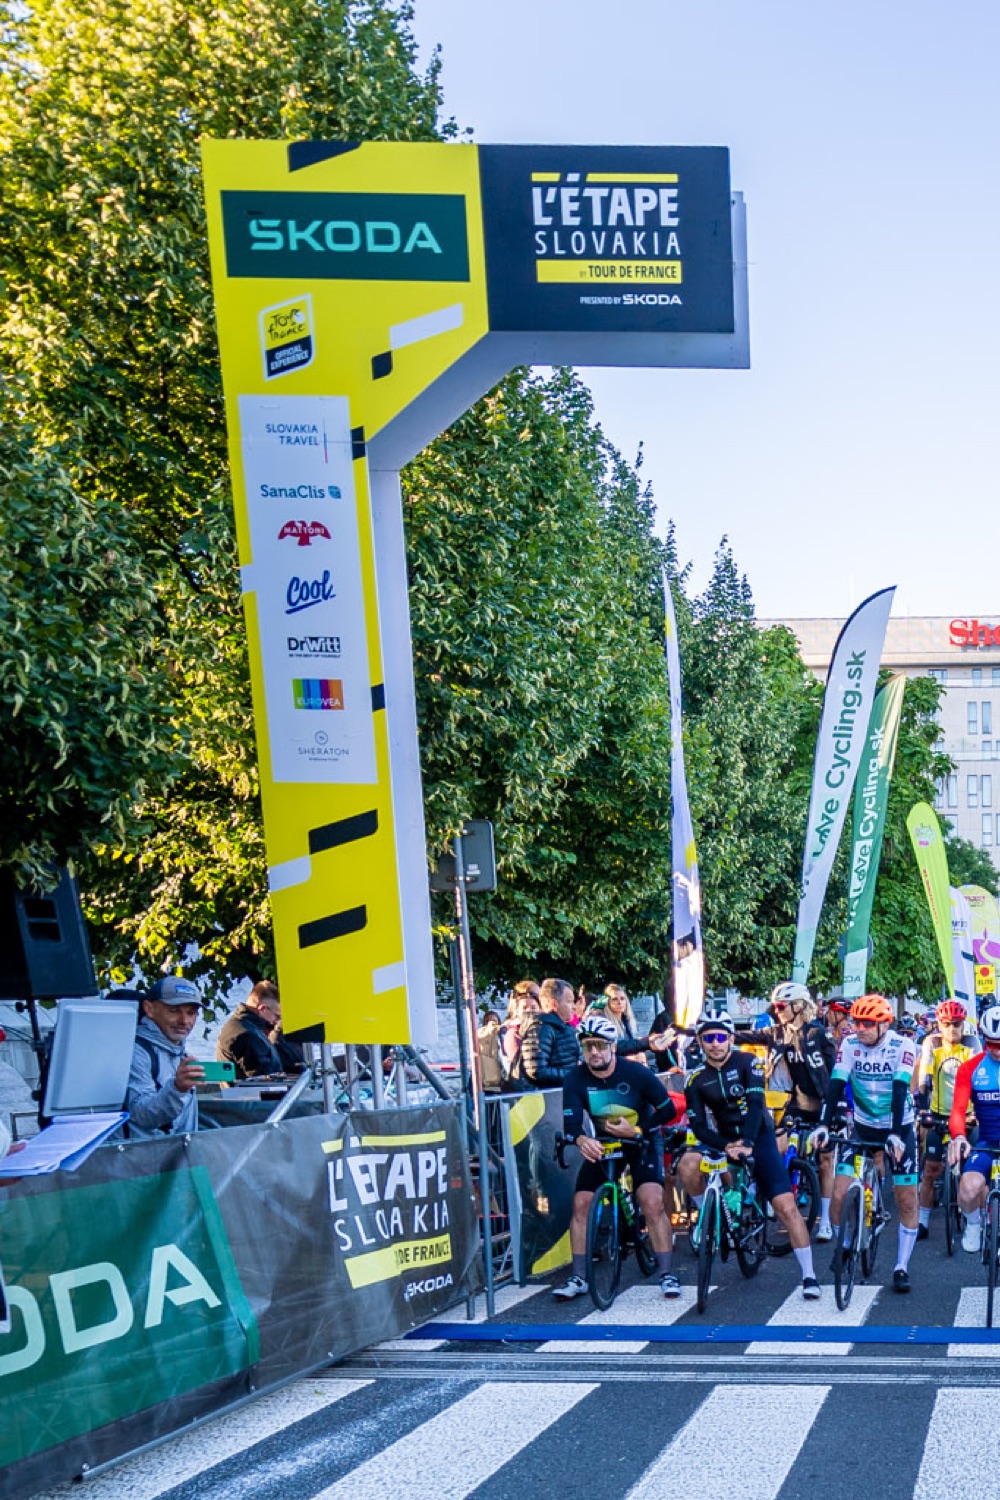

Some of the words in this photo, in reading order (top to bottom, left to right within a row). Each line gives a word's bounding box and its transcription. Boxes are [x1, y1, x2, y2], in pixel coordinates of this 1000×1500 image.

[534, 230, 681, 255] SLOVAKIA
[588, 265, 617, 278] TOUR
[619, 265, 632, 278] DE
[635, 265, 677, 278] FRANCE
[265, 423, 319, 433] SLOVAKIA
[279, 435, 319, 446] TRAVEL
[260, 484, 325, 499] SanaClis
[283, 526, 325, 534] MATTONI
[825, 650, 867, 789] Cycling.sk
[298, 747, 349, 755] SHERATON
[855, 1060, 892, 1073] BORA
[333, 1200, 450, 1251] SLOAKIA
